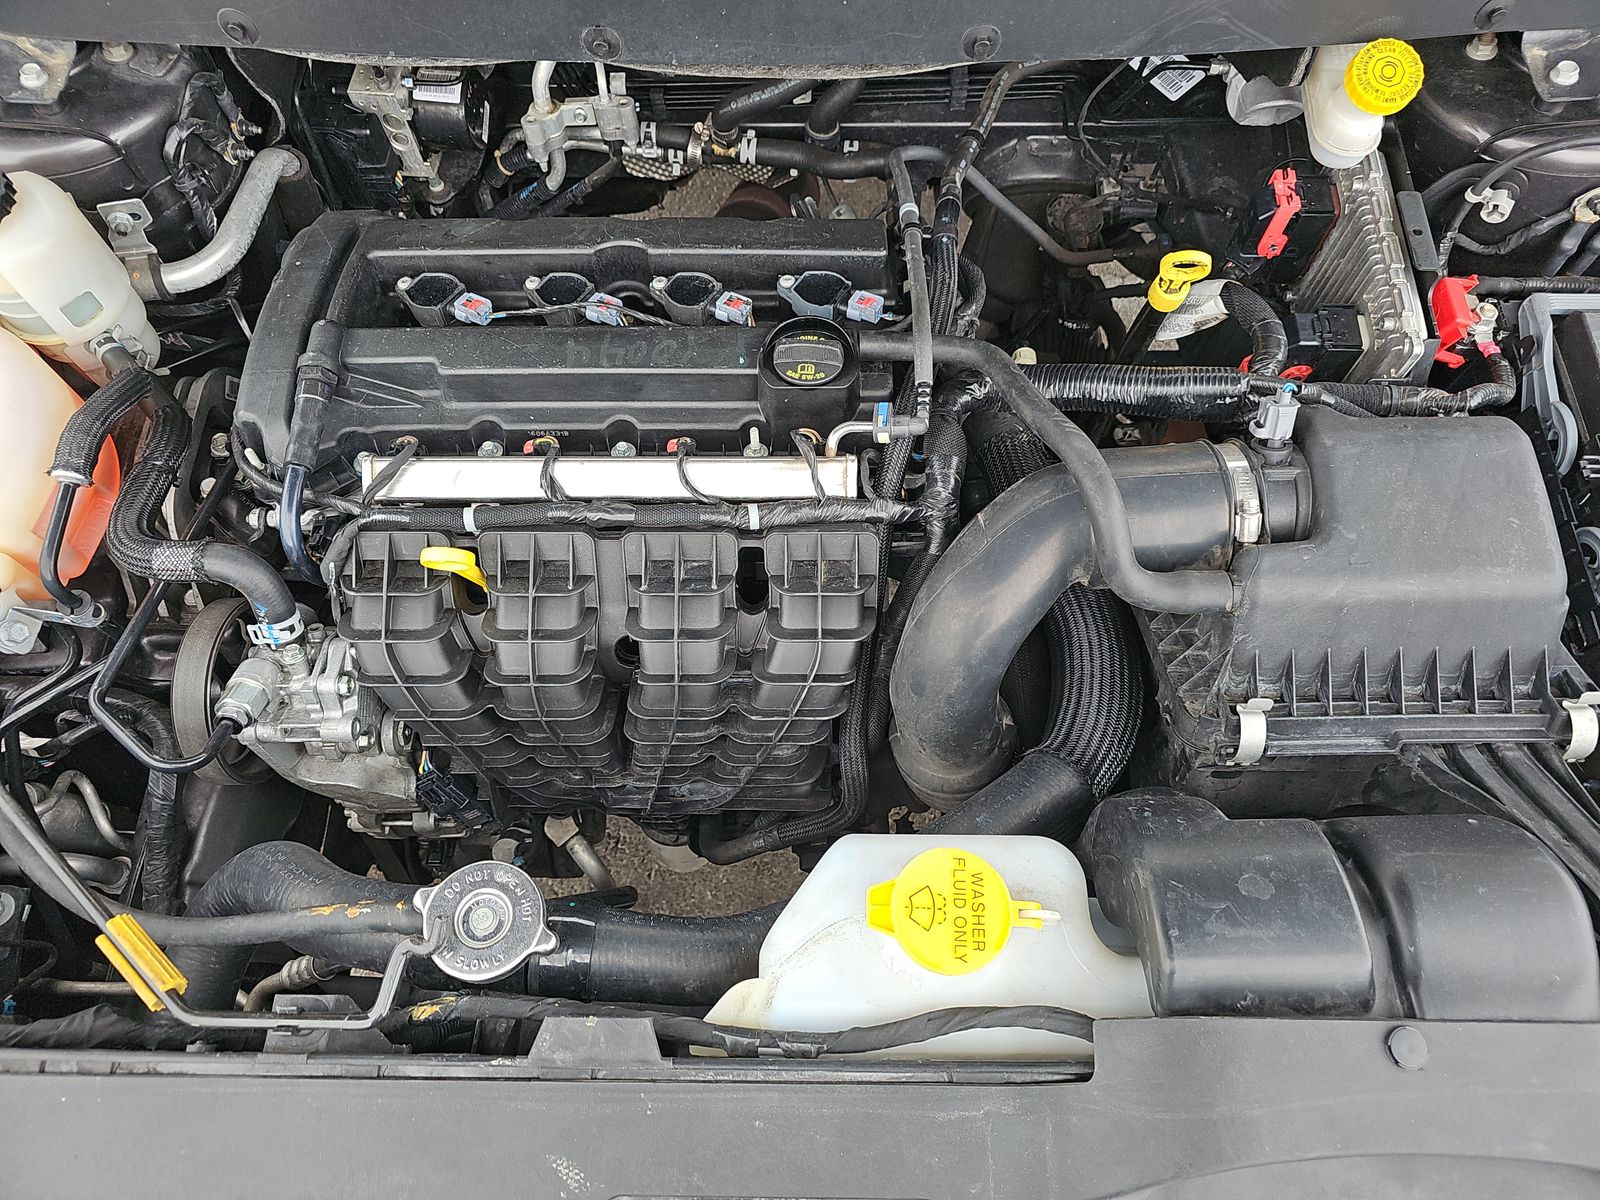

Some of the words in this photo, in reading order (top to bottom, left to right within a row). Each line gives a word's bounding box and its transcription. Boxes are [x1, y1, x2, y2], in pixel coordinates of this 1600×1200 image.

[785, 370, 801, 380] SAE
[801, 372, 826, 381] 5W-20
[444, 882, 461, 899] DO
[464, 869, 491, 885] NOT
[495, 869, 527, 897] OPEN
[521, 898, 534, 923] HOT
[953, 857, 967, 909] FLUID
[971, 872, 986, 952] WASHER
[454, 954, 506, 971] SLOWLY
[953, 916, 968, 964] ONLY
